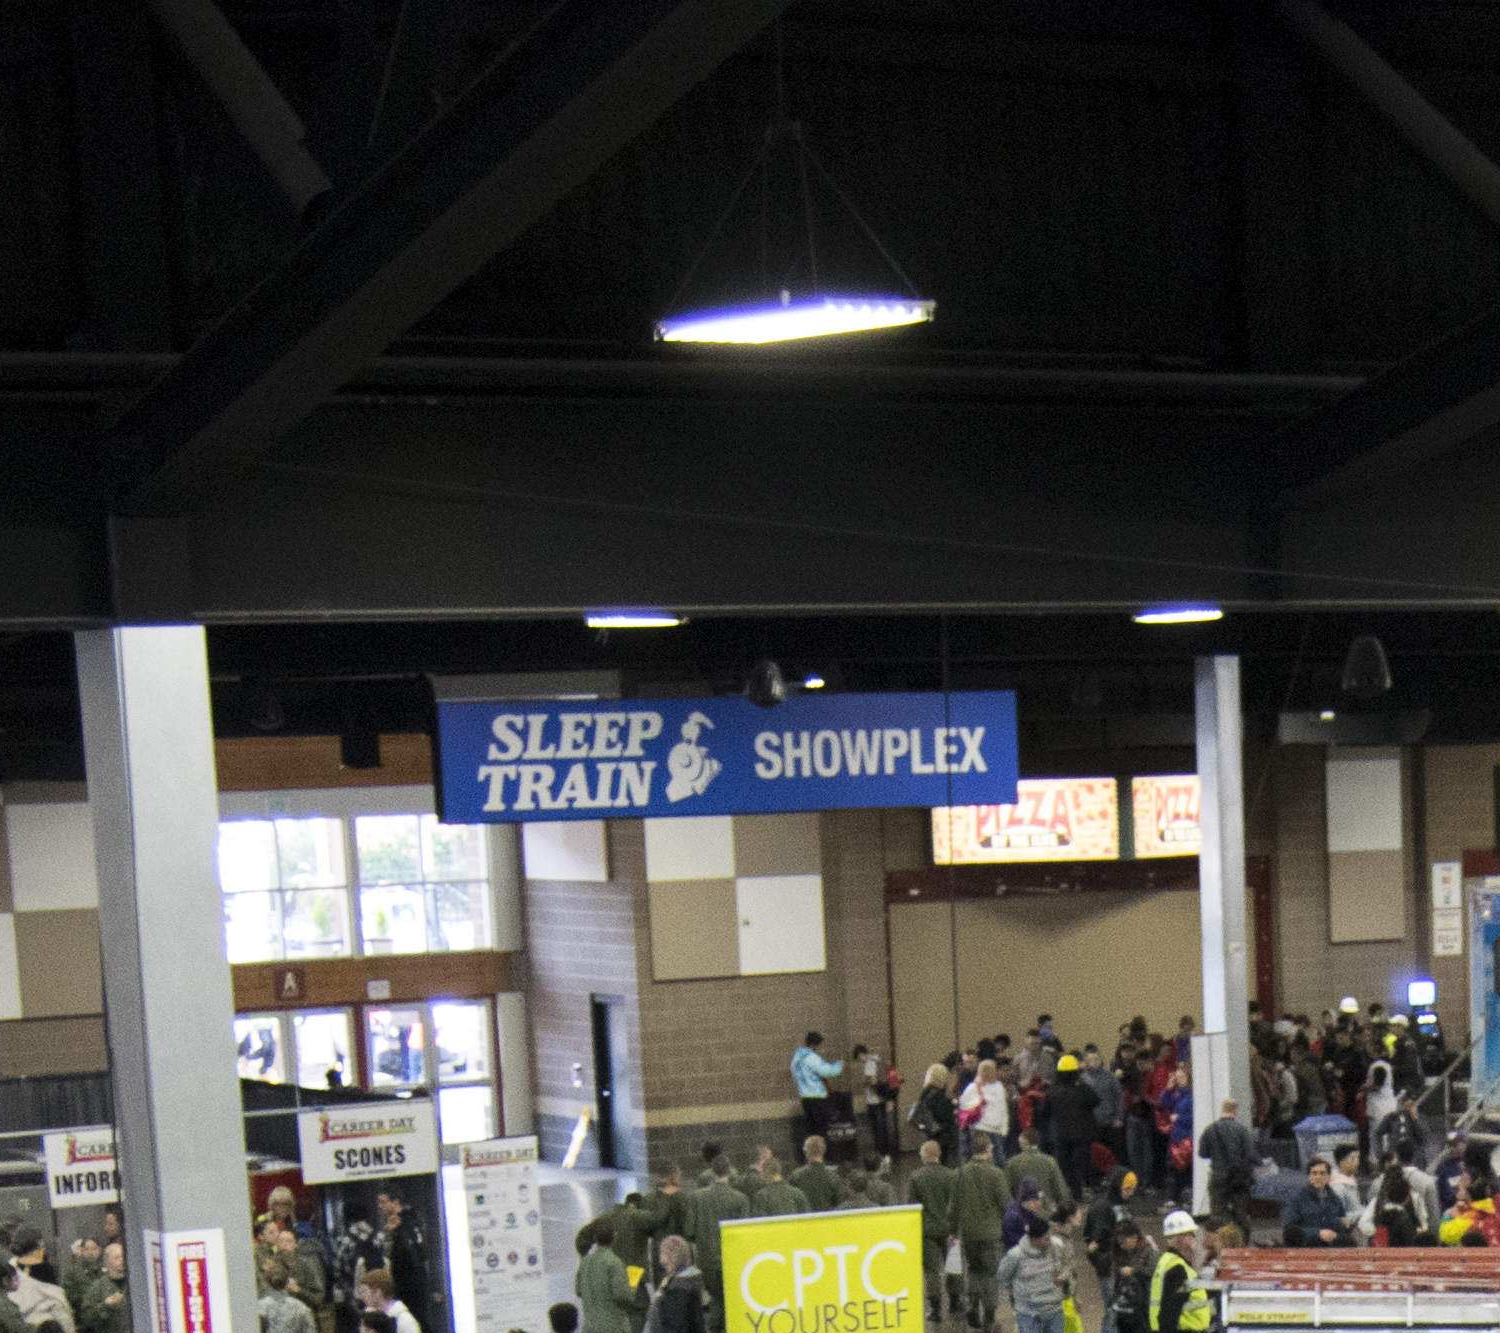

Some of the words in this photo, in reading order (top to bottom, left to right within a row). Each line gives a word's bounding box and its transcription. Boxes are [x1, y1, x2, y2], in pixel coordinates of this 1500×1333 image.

[487, 711, 663, 761] SLEEP
[753, 726, 988, 780] SHOWPLEX
[477, 761, 657, 812] TRAIN
[283, 970, 298, 996] A
[331, 1118, 387, 1134] CAREER
[389, 1116, 416, 1130] DAY
[333, 1143, 407, 1170] SCONES
[739, 1239, 909, 1316] CPTC
